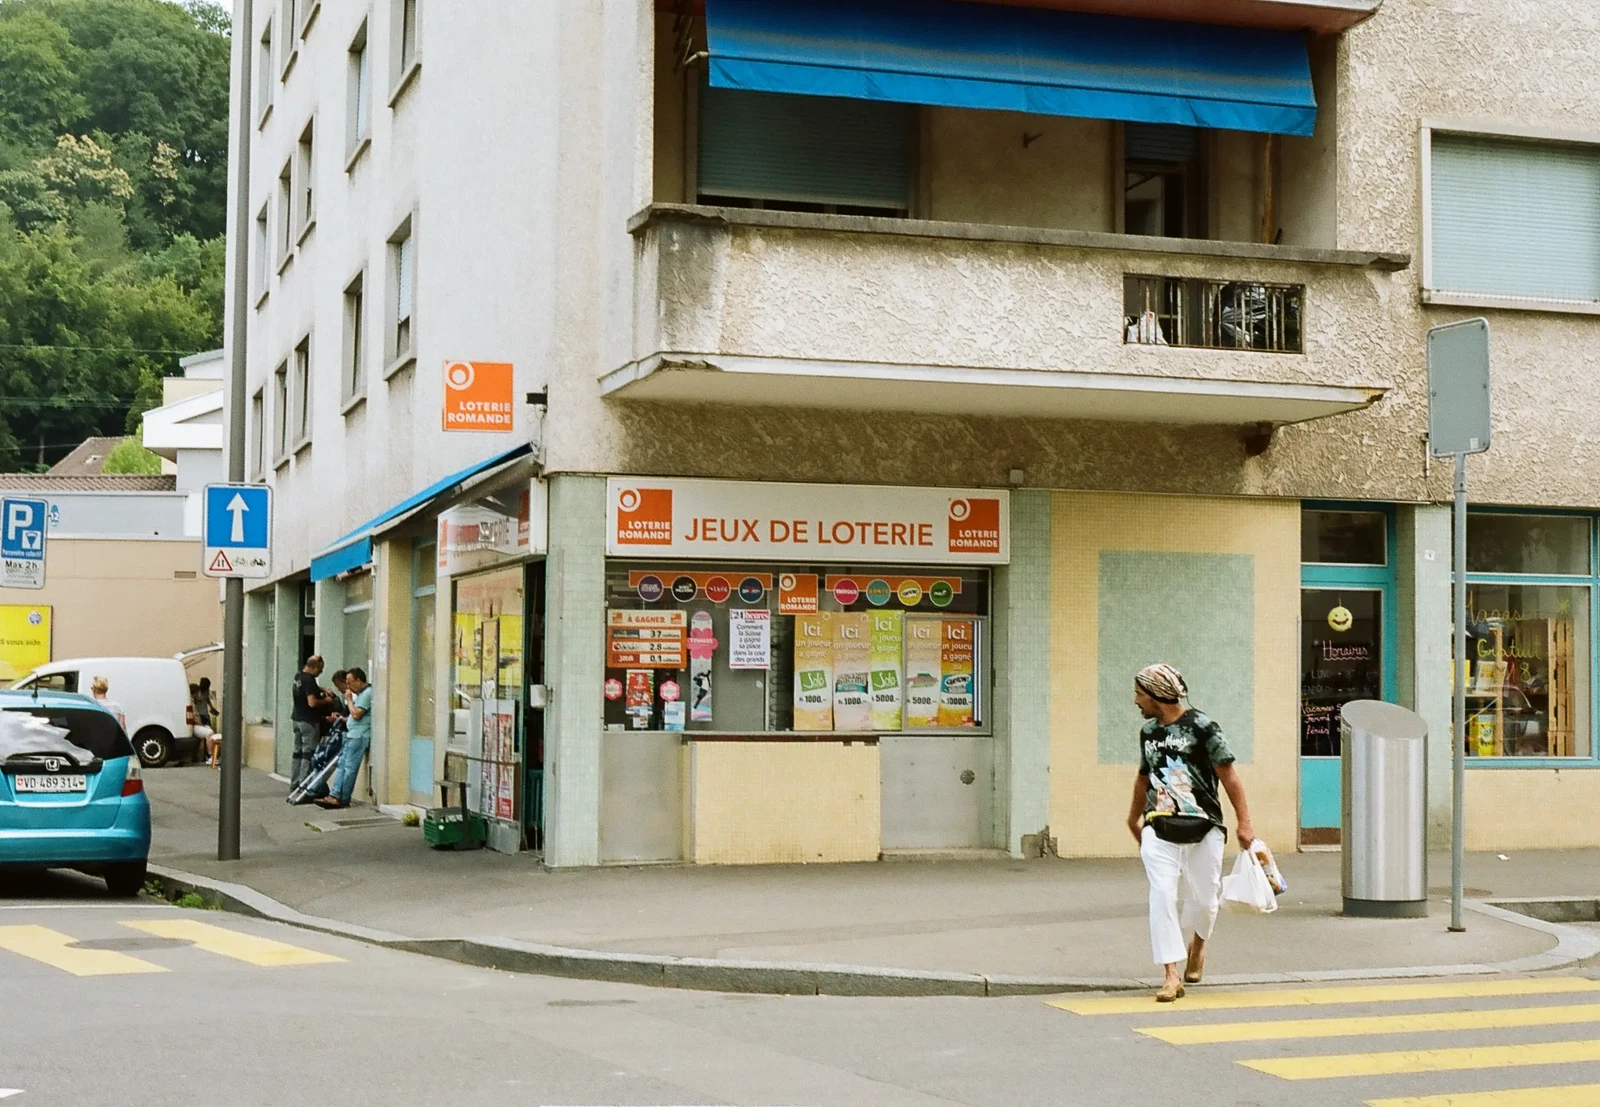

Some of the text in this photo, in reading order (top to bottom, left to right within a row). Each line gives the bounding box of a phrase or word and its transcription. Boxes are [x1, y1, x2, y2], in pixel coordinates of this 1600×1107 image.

[460, 401, 510, 412] LOTERIE
[448, 412, 510, 424] ROMANDE
[8, 504, 33, 540] P
[628, 520, 670, 530] LOTERIE
[619, 530, 670, 540] ROMANDE
[684, 518, 933, 546] JEUX DE LOTERIE
[959, 530, 998, 538] LOTERIE
[950, 539, 998, 548] ROMANDE
[951, 642, 972, 652] joueu
[1322, 640, 1368, 658] Horaires
[1477, 638, 1543, 660] Gratuit
[949, 652, 972, 662] gagné
[24, 778, 36, 788] VD
